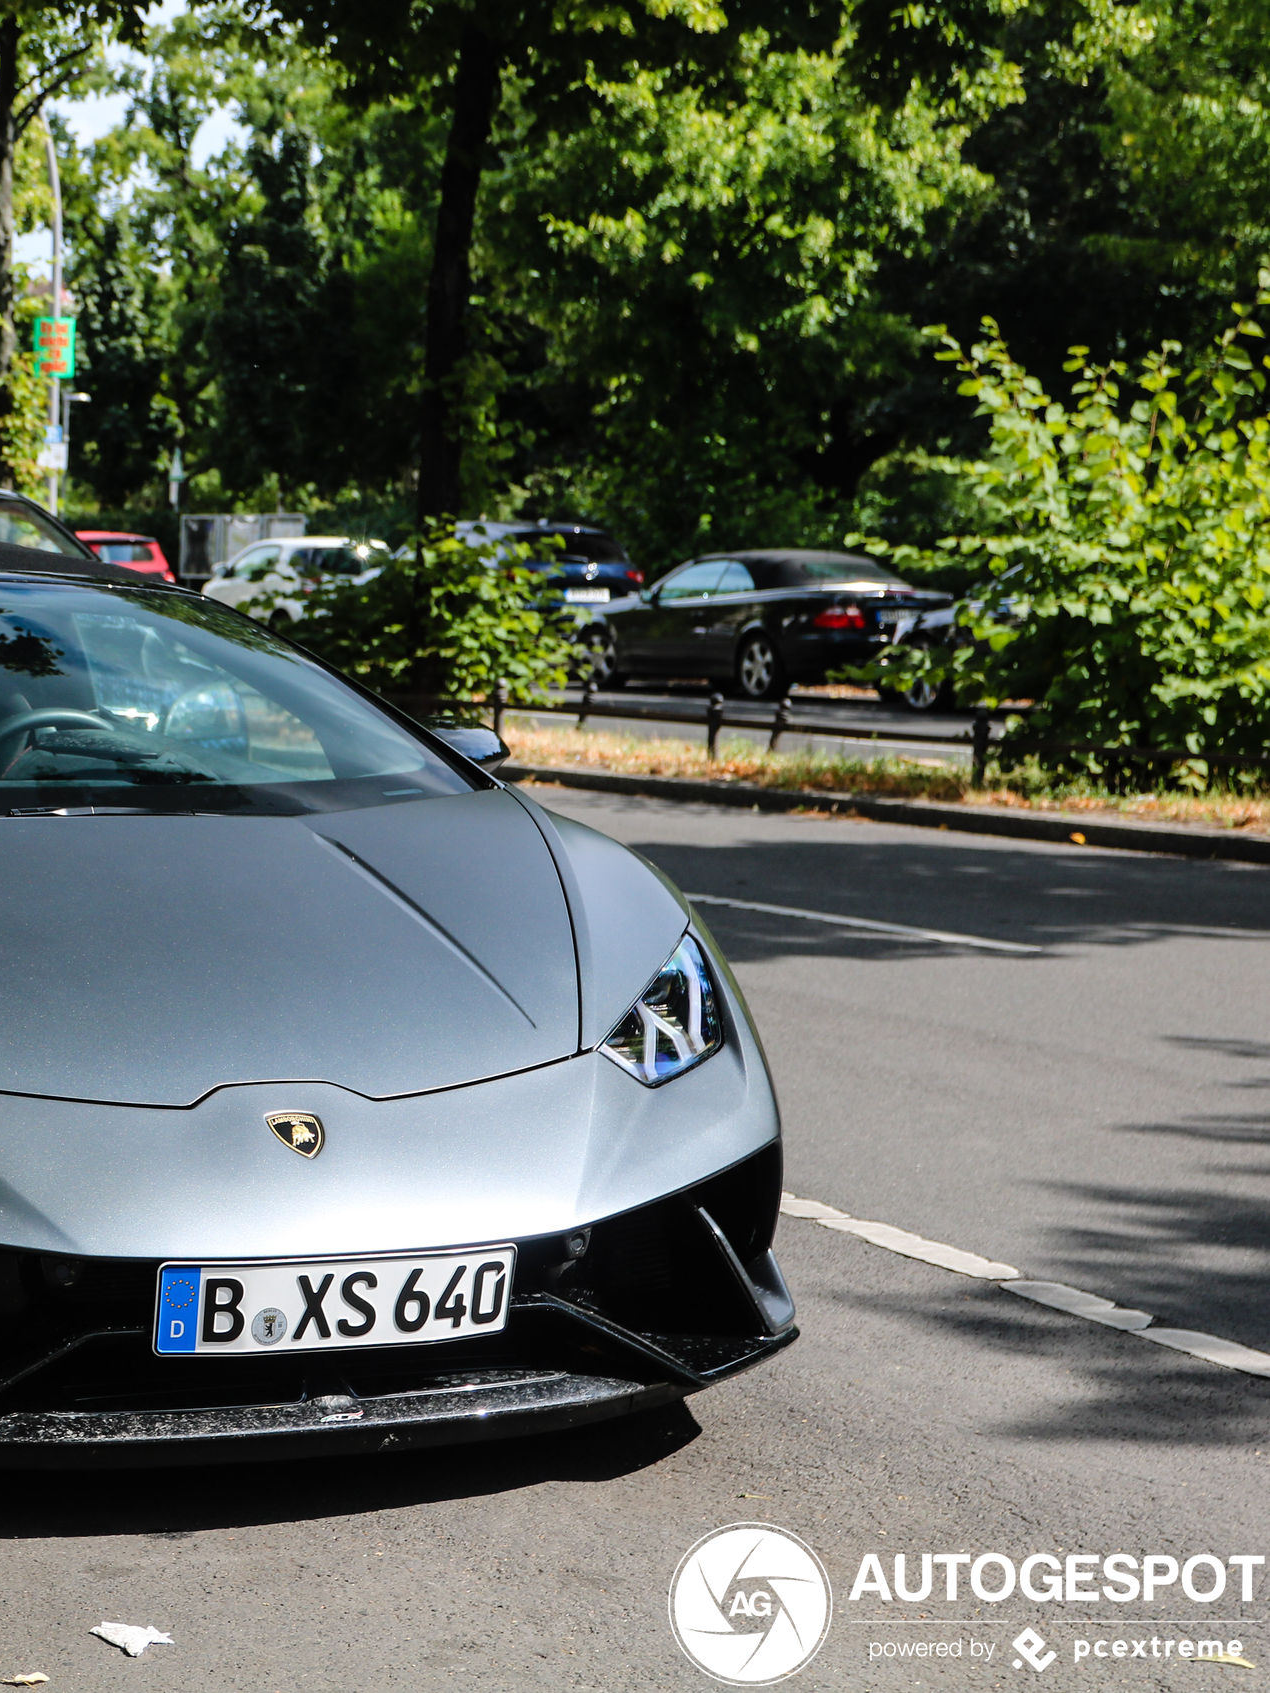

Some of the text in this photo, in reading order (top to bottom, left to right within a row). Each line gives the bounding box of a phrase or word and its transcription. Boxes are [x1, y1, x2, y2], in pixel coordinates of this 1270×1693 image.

[202, 1261, 505, 1342] B XS 640
[170, 1320, 185, 1338] D
